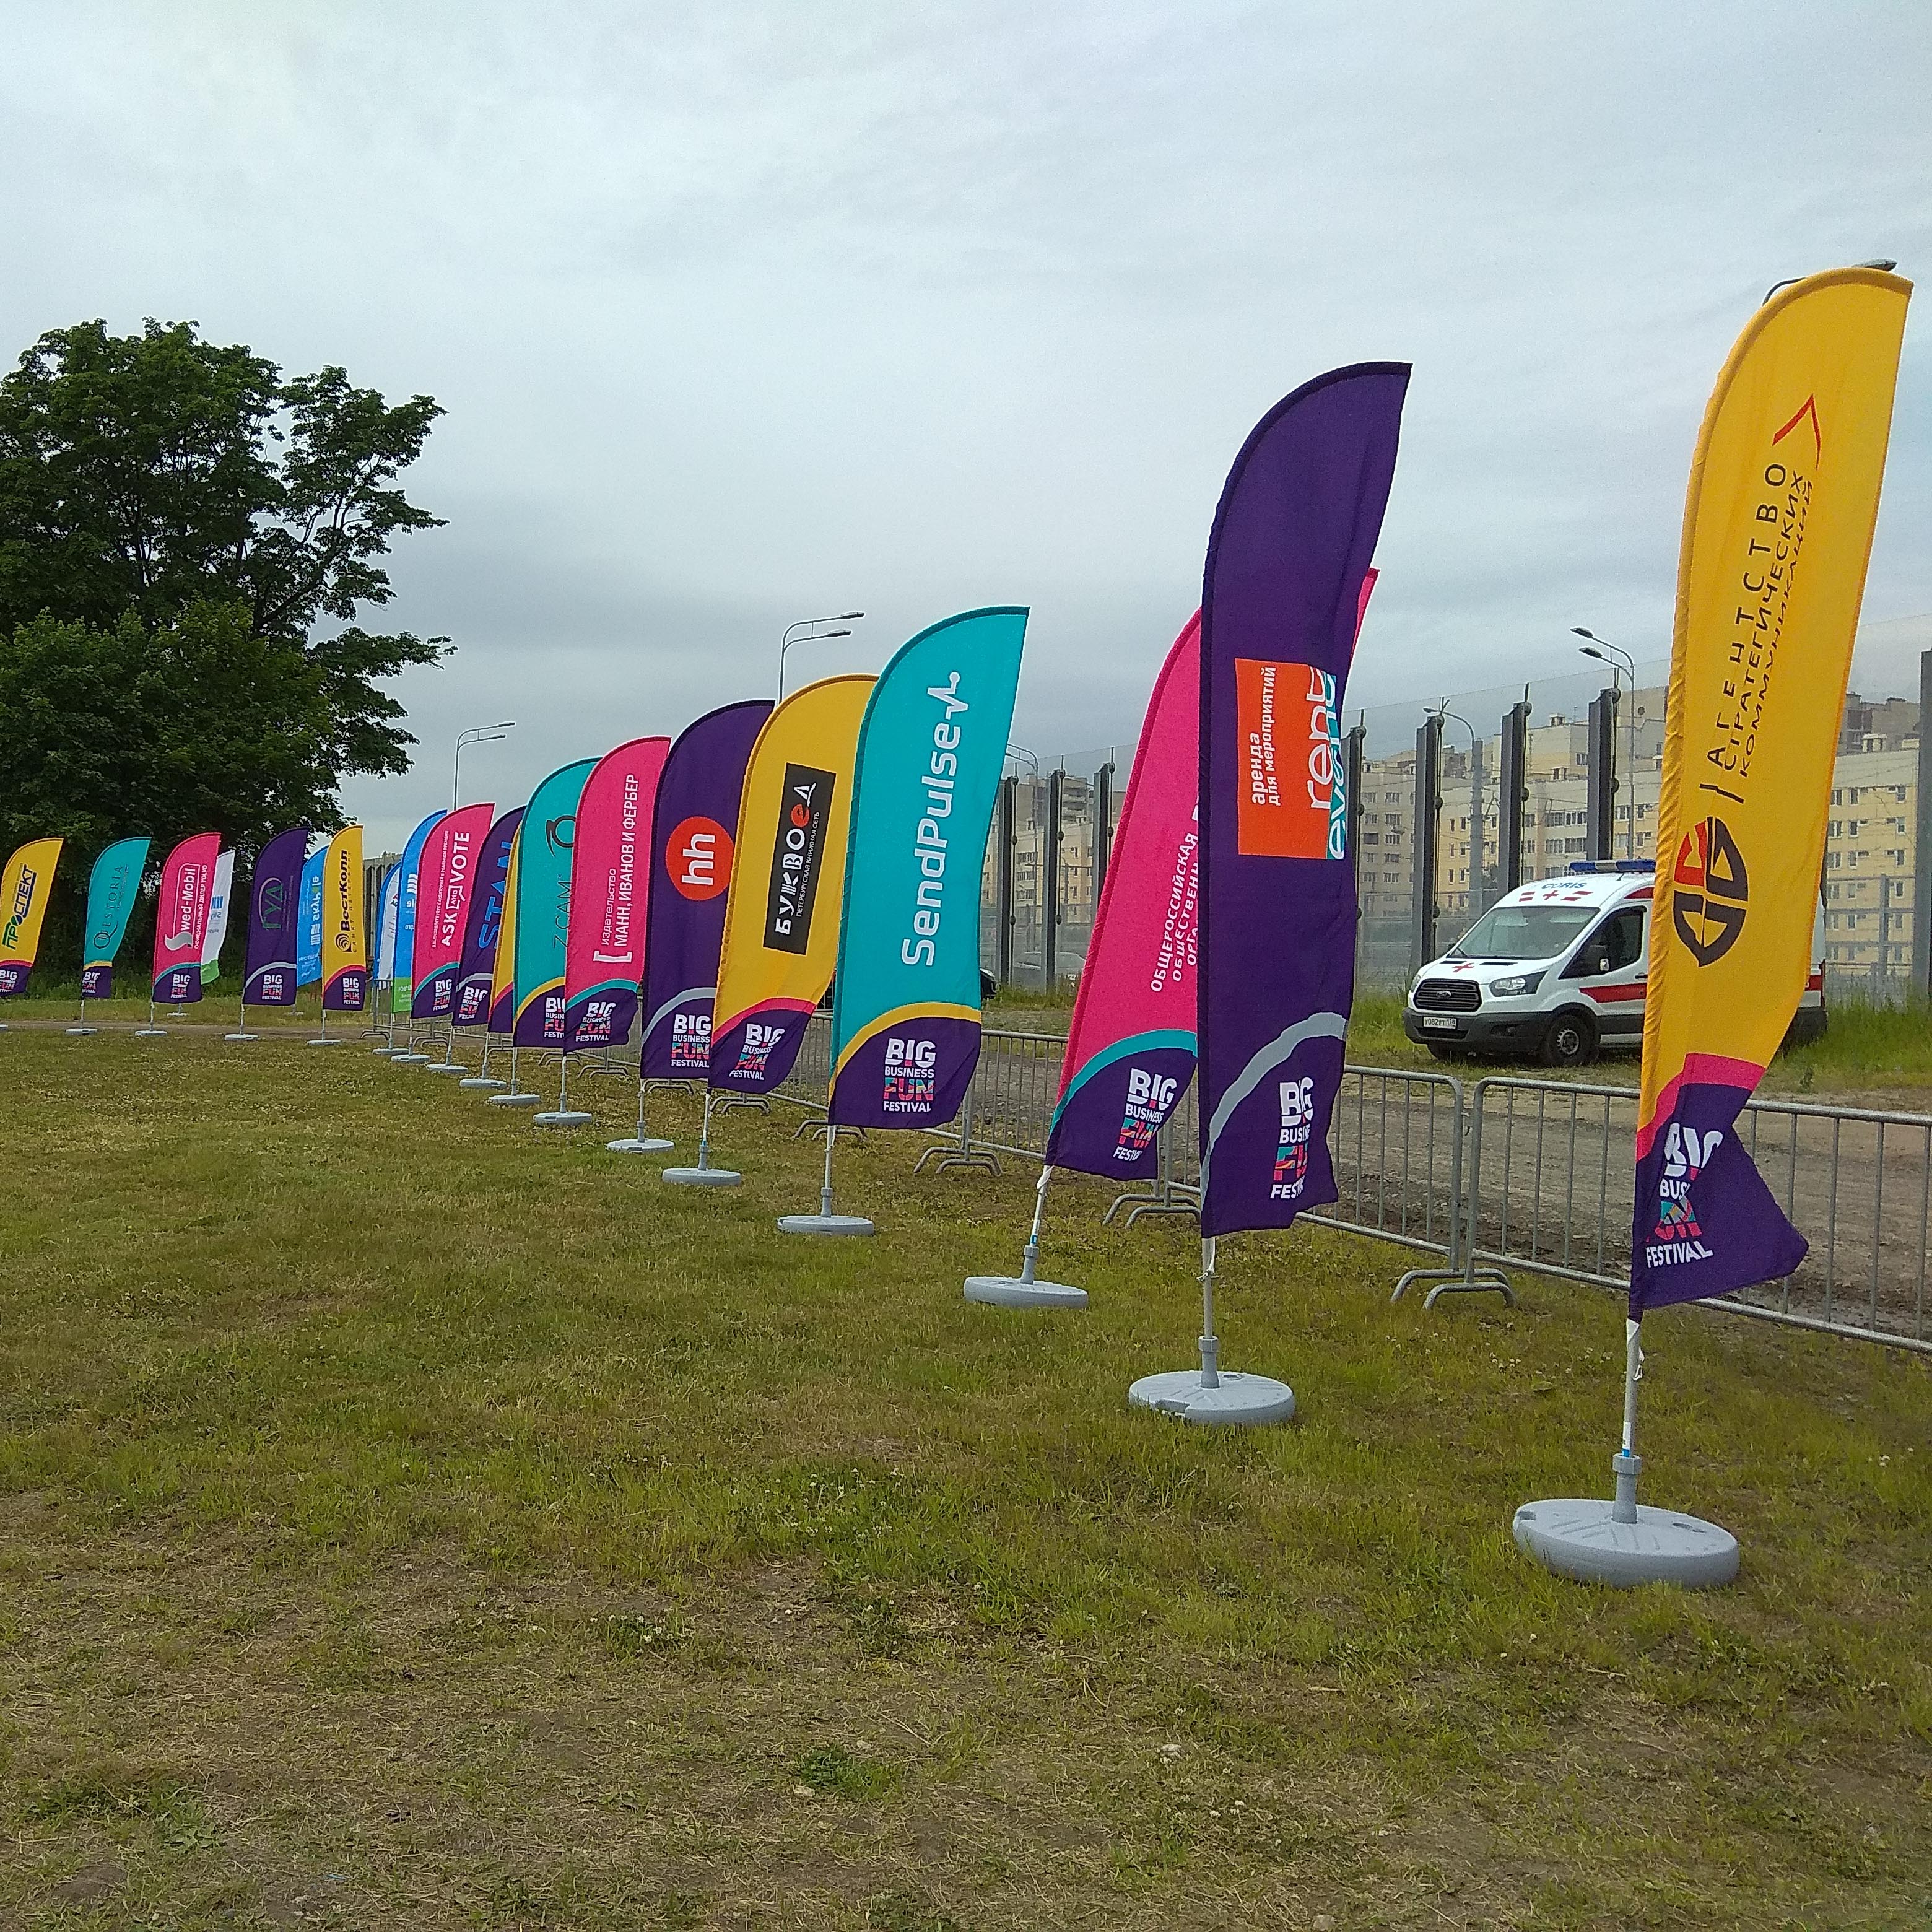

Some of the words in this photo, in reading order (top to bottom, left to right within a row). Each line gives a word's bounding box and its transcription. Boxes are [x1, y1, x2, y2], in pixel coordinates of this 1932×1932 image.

[1707, 463, 1786, 767] АГЕНТСТВО
[1724, 469, 1806, 771] СТРАТЕГИЧЕСКИХ
[1739, 480, 1813, 777] КОММУНИКАЦИЙ
[1260, 666, 1276, 772] мероприятий
[1307, 666, 1333, 810] rent
[1249, 733, 1266, 804] аренда
[622, 774, 638, 830] ФЕРБЕР
[1266, 777, 1281, 806] для
[622, 832, 635, 842] И
[900, 721, 960, 967] SendPulse
[618, 843, 635, 902] ИВАНОВ
[681, 833, 715, 886] hh
[796, 864, 811, 918] ПЕТЕРБУРГСКАЯ
[806, 830, 816, 864] КНИЖНАЯ
[812, 812, 820, 829] СЕТЬ
[442, 912, 458, 946] ASK
[450, 832, 469, 884] VOTE
[614, 903, 633, 947] МАНН,
[1151, 833, 1199, 992] ОБЩЕРОССИЙСКАЯ
[1172, 861, 1199, 981] ОБЩЕСТВЕНН
[173, 973, 191, 985] BIG
[263, 974, 282, 985] BIG
[342, 977, 359, 988] BIG
[435, 978, 452, 993] BIG
[546, 997, 565, 1012] BI
[544, 1019, 565, 1032] FU
[576, 1020, 611, 1035] FUN
[672, 1035, 710, 1043] BUSINESS
[673, 1014, 711, 1035] BIG
[671, 1042, 710, 1060] FUN
[671, 1059, 710, 1068] FESTIVAL
[884, 1038, 936, 1068] BIG
[729, 1069, 765, 1081] FESTIVAL
[884, 1066, 935, 1079] BUSINESS
[883, 1077, 934, 1101] FUN
[1126, 1068, 1177, 1111] BIG
[883, 1100, 931, 1113] FESTIVAL
[1273, 1142, 1308, 1181] FU
[1645, 1240, 1713, 1269] FESTIVAL
